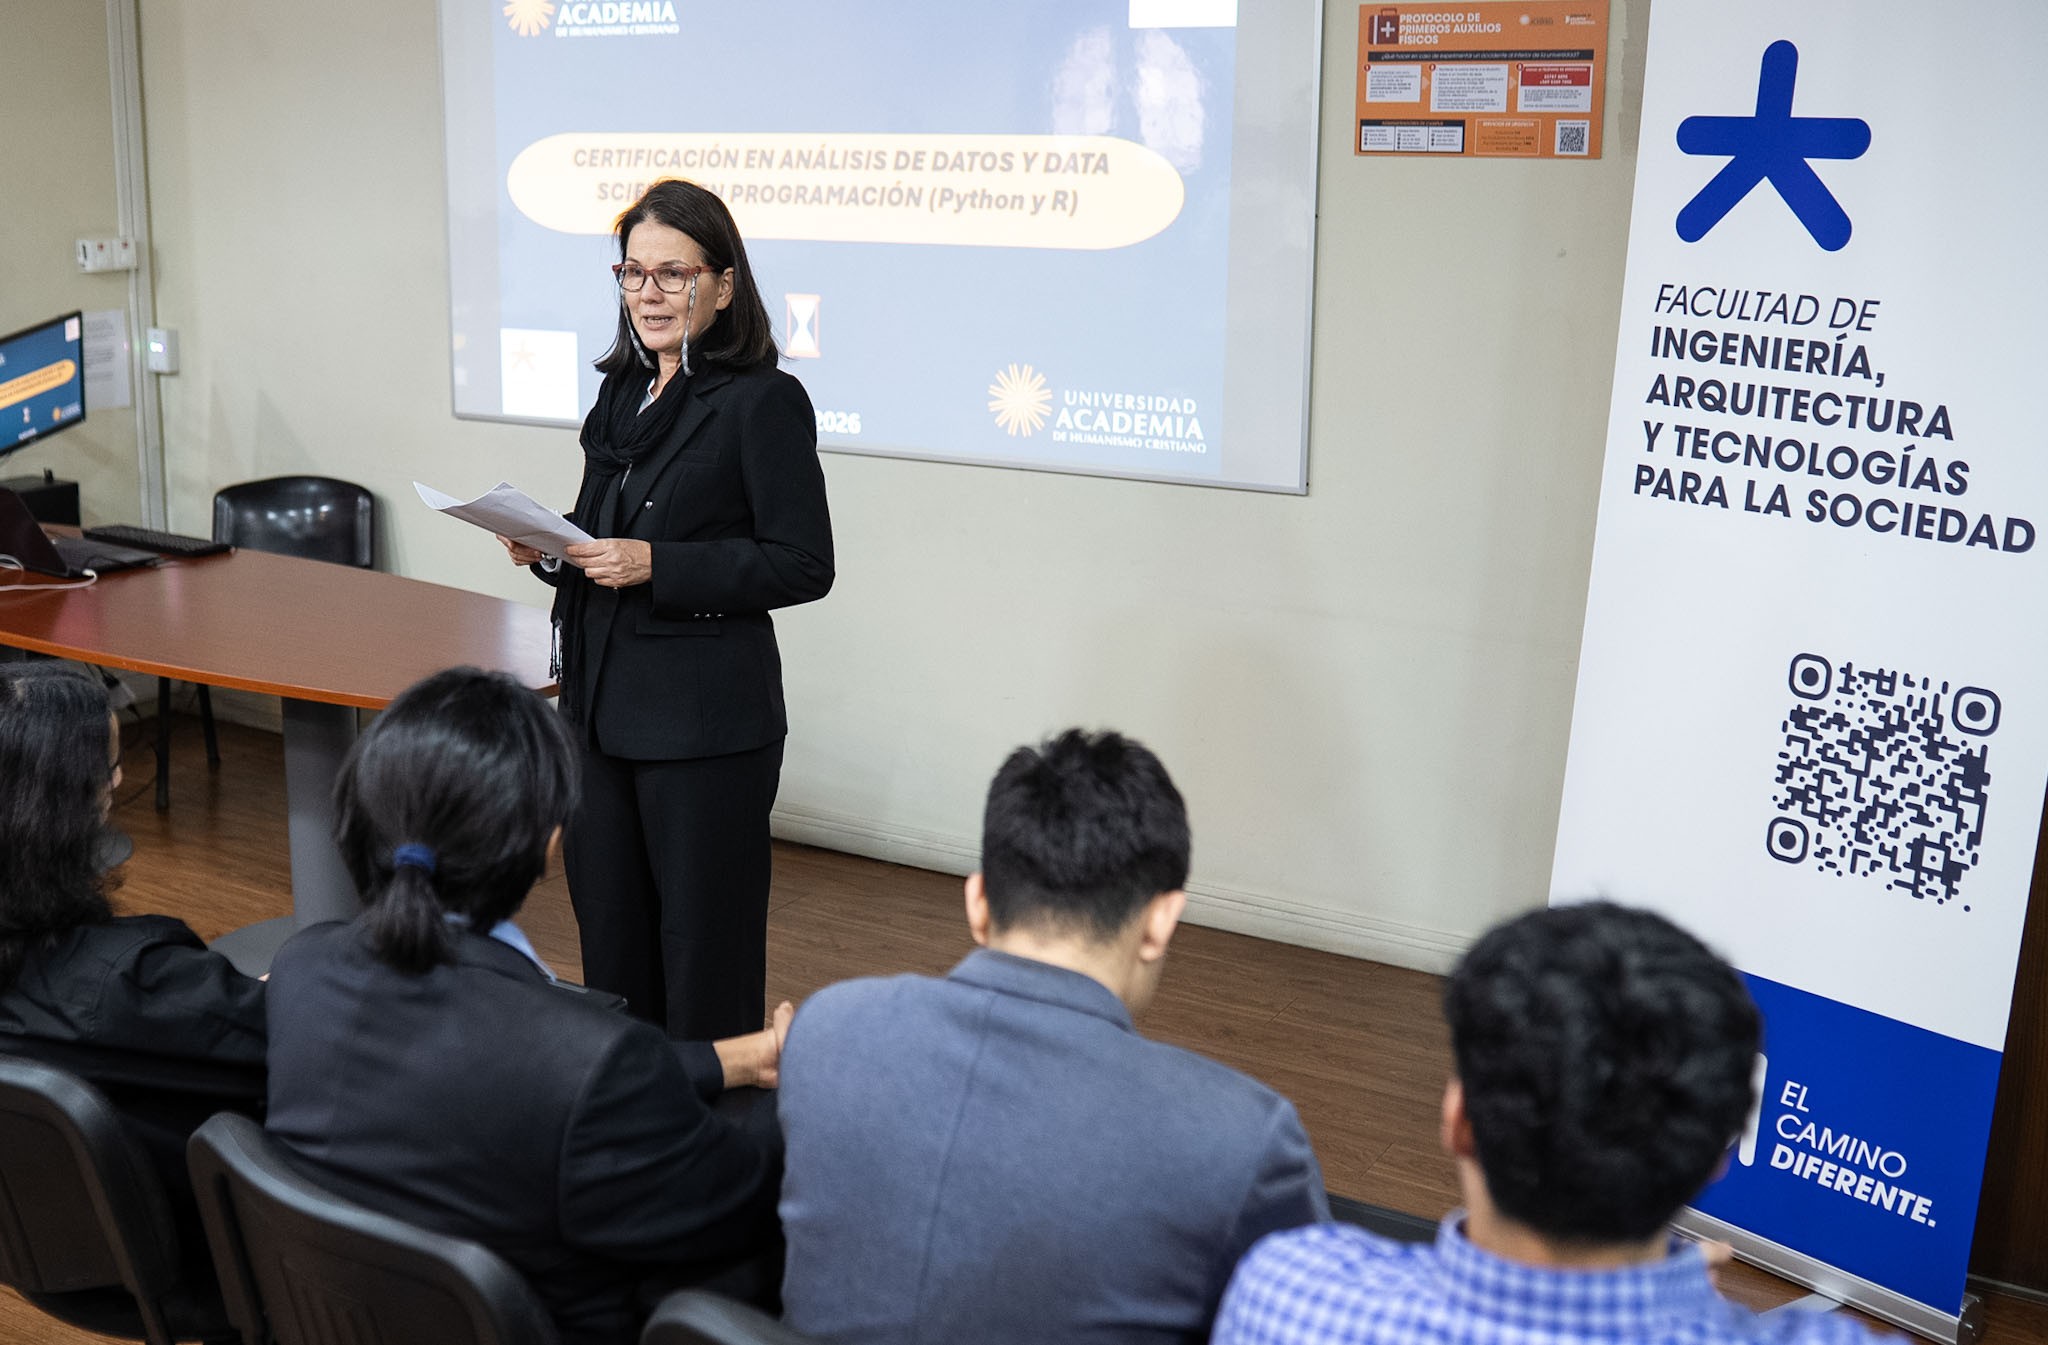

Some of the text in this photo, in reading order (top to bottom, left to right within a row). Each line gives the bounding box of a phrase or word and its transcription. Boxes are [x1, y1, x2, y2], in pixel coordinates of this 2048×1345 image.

[557, 1, 677, 25] ACADEMIA
[1399, 12, 1480, 23] PROTOCOLO DE
[1399, 23, 1501, 34] PRIMEROS AUXILIOS
[1399, 33, 1438, 45] FÍSICOS
[574, 144, 1110, 175] CERTIFICACIÓN EN ANÁLISIS DE DATOS Y DATA
[597, 182, 648, 202] SCIE
[730, 181, 923, 207] PROGRAMACIÓN
[929, 187, 1025, 214] (Python
[1030, 194, 1046, 215] y
[1051, 190, 1079, 217] R)
[1654, 284, 1881, 332] FACULTAD DE
[1650, 326, 1886, 388] INGENIERÍA,
[1065, 389, 1197, 415] UNIVERSIDAD
[1645, 373, 1955, 441] ARQUITECTURA
[815, 410, 861, 434] 2026
[1055, 408, 1204, 440] ACADEMIA
[1053, 431, 1207, 454] DE HUMANISMO CRISTIANO
[1643, 420, 1970, 497] Y TECNOLOGÍAS
[1633, 464, 2036, 554] PARA LA SOCIEDAD
[1779, 1080, 1809, 1113] EL
[1776, 1114, 1907, 1178] CAMINO
[1770, 1143, 1937, 1228] DIFERENTE.
